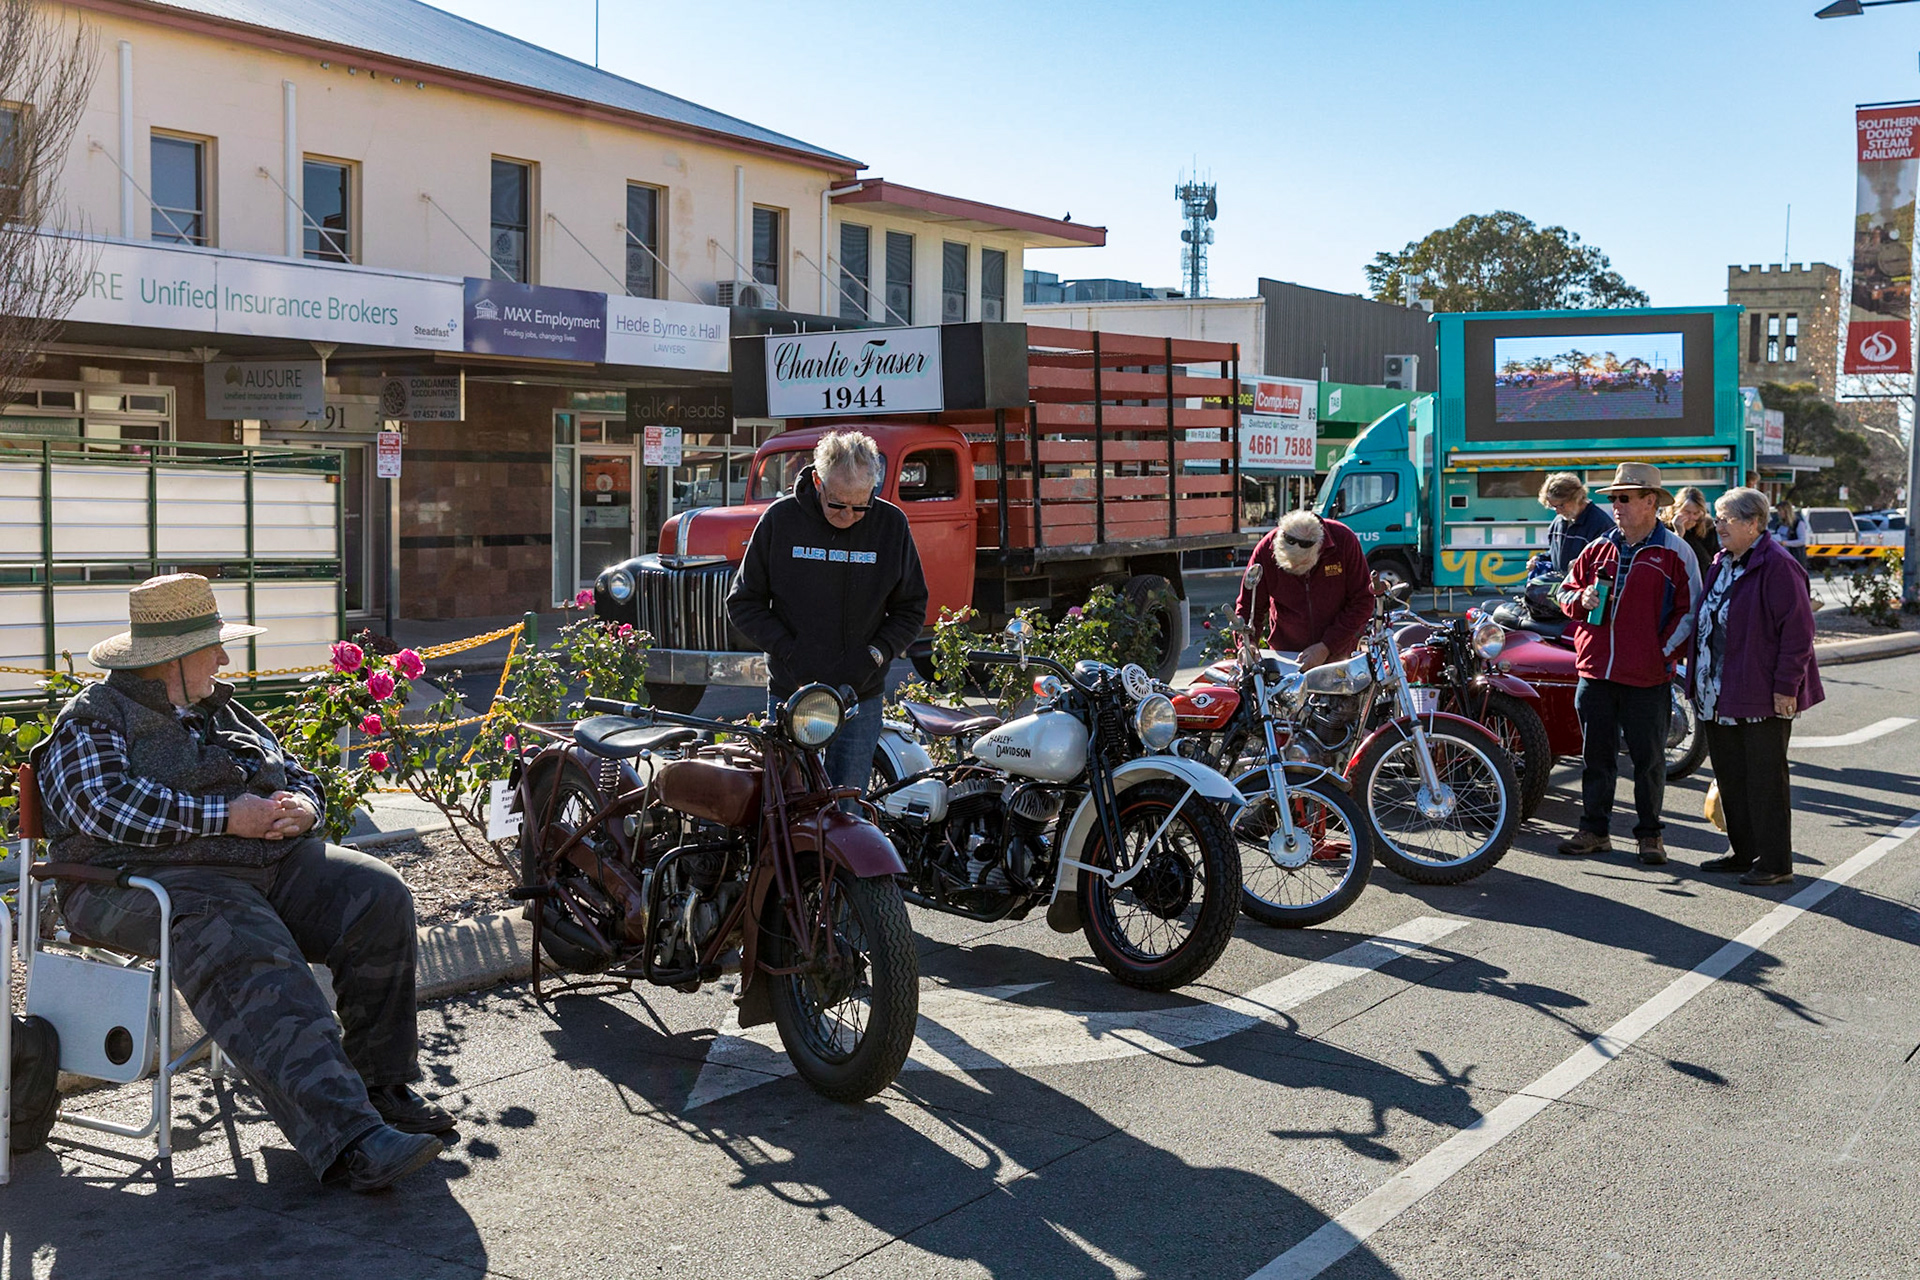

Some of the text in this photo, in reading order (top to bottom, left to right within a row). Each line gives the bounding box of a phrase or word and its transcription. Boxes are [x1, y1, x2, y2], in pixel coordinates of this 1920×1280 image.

[1858, 116, 1920, 130] SOUTHERN
[1866, 127, 1913, 139] DOWNS
[1868, 138, 1909, 149] STEAM
[1862, 147, 1914, 160] RAILWAY
[140, 277, 217, 309] Unified
[225, 286, 321, 319] Insurance
[328, 297, 398, 326] Brokers
[504, 306, 600, 331] MAX Employment
[414, 325, 449, 337] Steadfast
[616, 315, 721, 339] Hede Byrne & Hall
[503, 328, 524, 339] Finding
[539, 332, 563, 342] changing
[653, 343, 687, 354] LAWYERS
[774, 339, 929, 381] Charlie Fraser
[245, 369, 303, 388] AUSURE
[410, 379, 458, 389] CONDAMINE
[224, 392, 303, 400] Unified Insurance Brokers
[411, 389, 458, 397] ACCOUNTANTS
[821, 385, 886, 410] 1944
[1258, 392, 1299, 411] Computers
[413, 410, 455, 418] 07 4527 4630
[1, 423, 25, 431] HOME
[1249, 418, 1272, 429] Switched
[1280, 421, 1299, 431] Service
[664, 427, 680, 438] 2P
[1249, 434, 1312, 457] 4661 7588
[1355, 532, 1380, 541] TUS
[996, 744, 1031, 758] DAVIDSON
